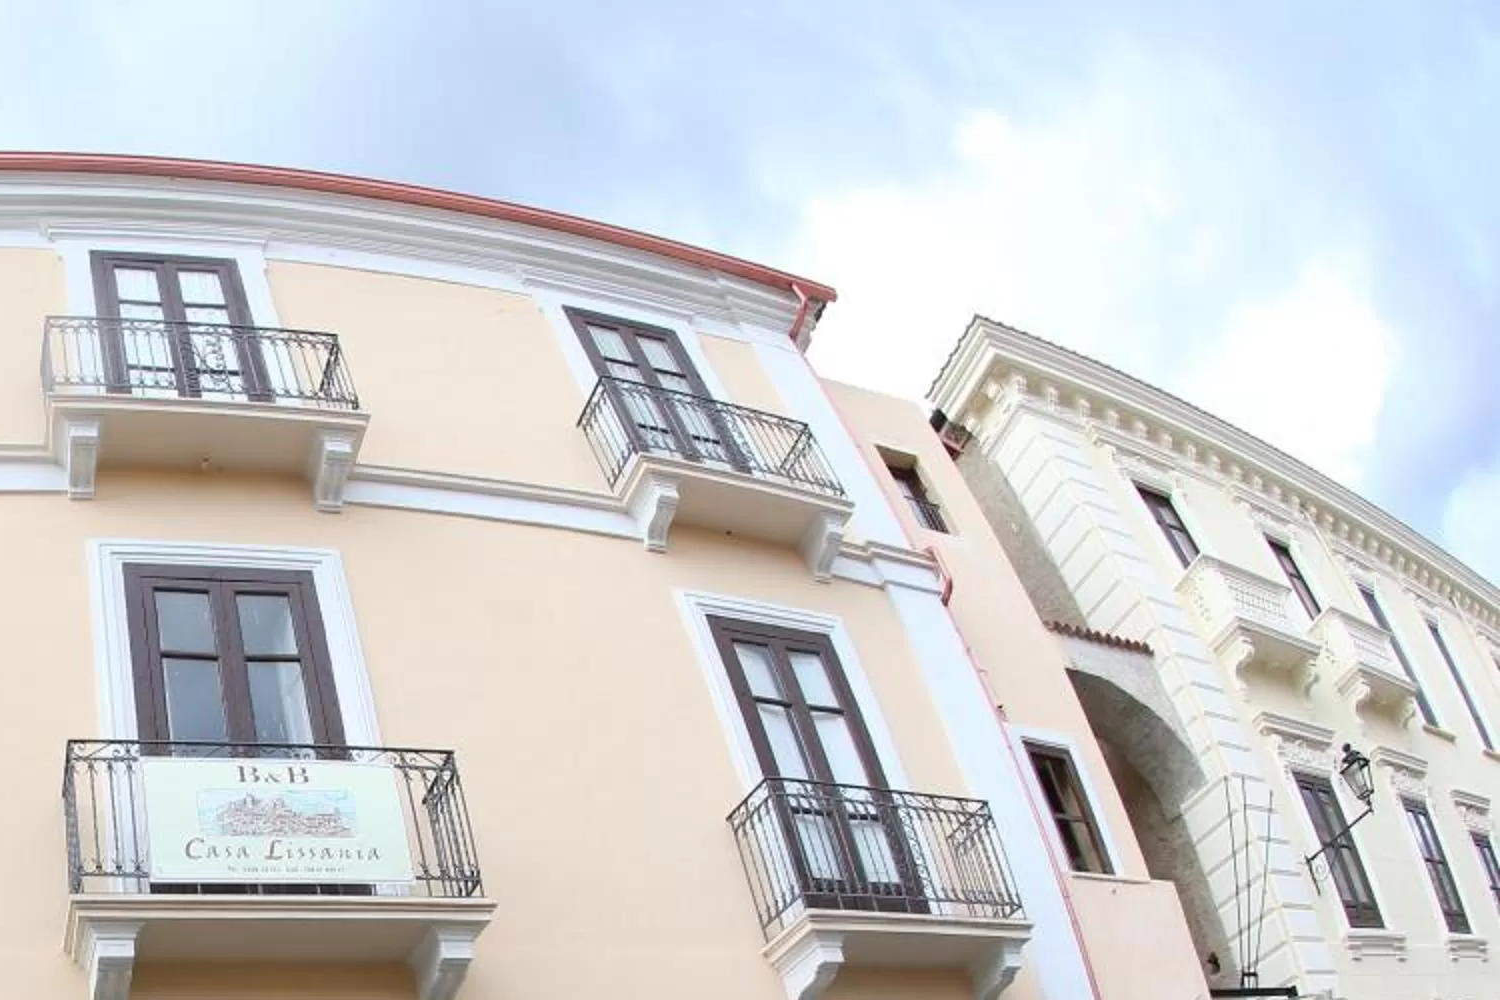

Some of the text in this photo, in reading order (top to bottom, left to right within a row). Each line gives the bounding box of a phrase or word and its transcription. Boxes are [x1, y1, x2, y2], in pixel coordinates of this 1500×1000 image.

[236, 765, 309, 784] B&B
[184, 837, 382, 862] Casa Lissania
